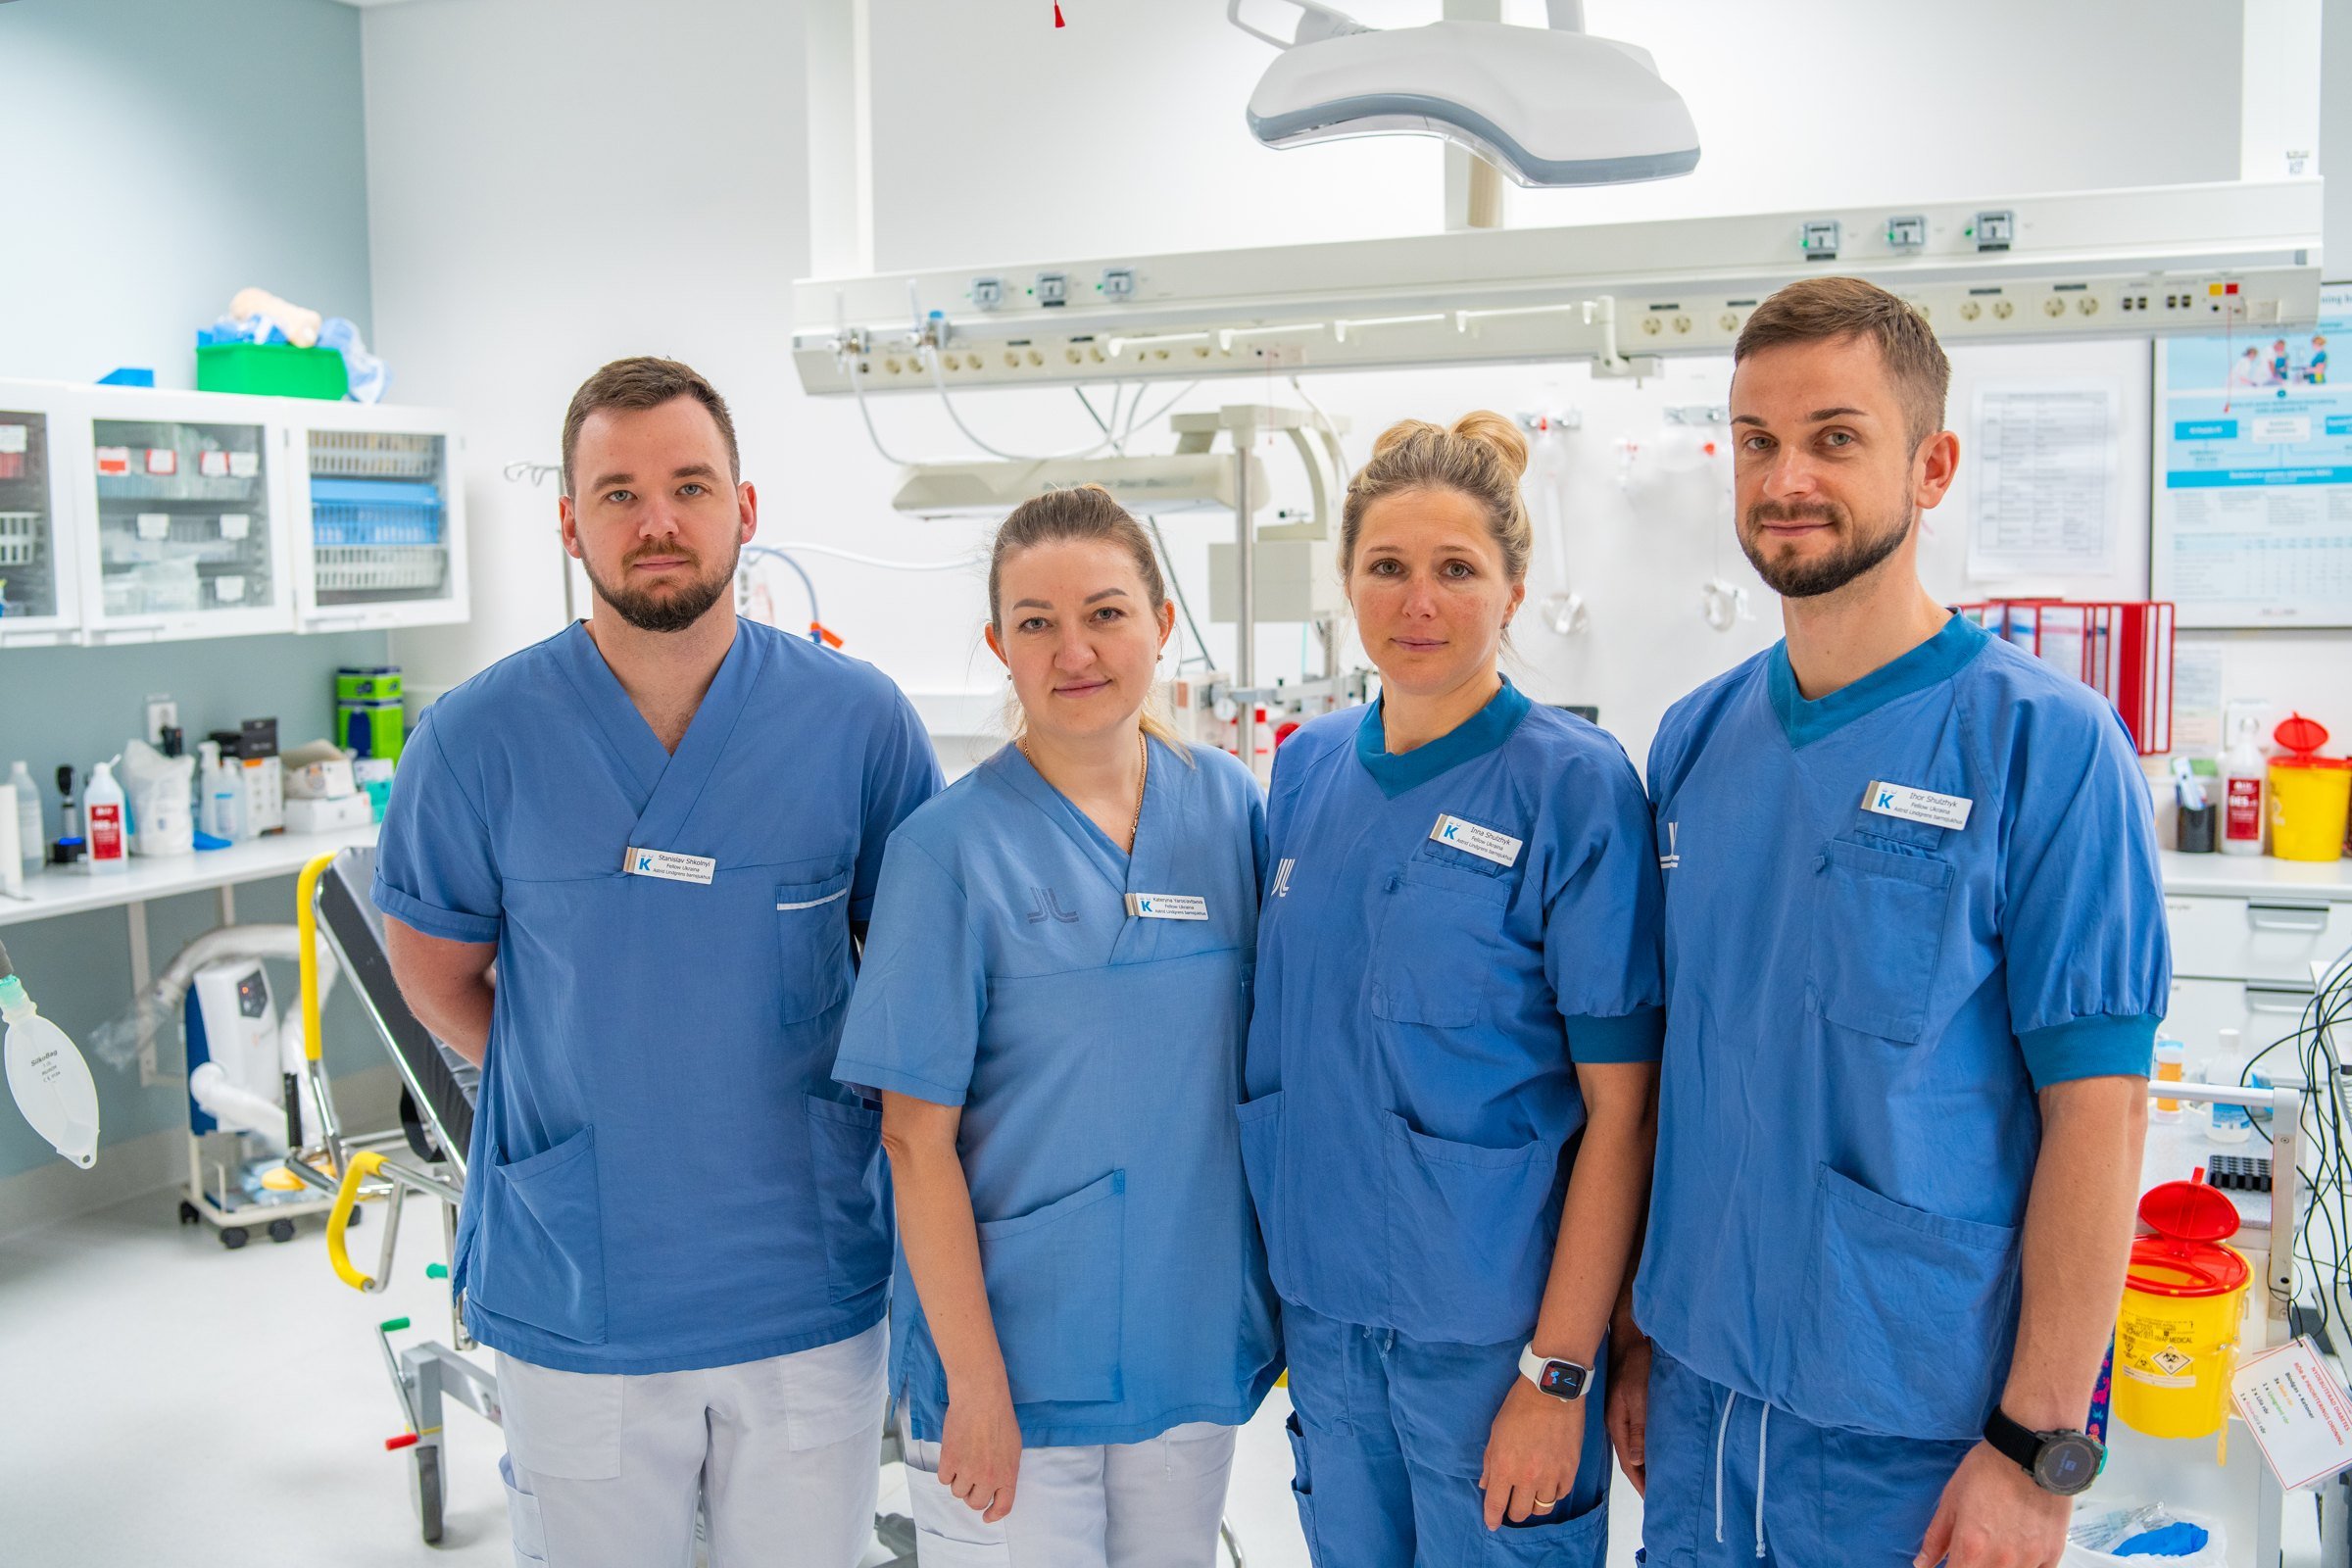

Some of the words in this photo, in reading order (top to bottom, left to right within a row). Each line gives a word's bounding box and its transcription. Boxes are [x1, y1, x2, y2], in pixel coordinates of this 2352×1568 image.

[1909, 793, 1924, 801] Ihor
[1926, 796, 1957, 808] Shulzhyk
[1909, 810, 1932, 819] Lindgrens
[1471, 827, 1484, 836] Inna
[1485, 833, 1510, 846] Shulzhyk
[1471, 836, 1486, 844] Fellow
[1486, 841, 1503, 850] Ukraina
[1469, 843, 1488, 853] Lindgrens
[1489, 850, 1512, 861] barnsjukhus
[659, 855, 684, 863] Stanislav
[686, 858, 710, 867] Shkolnyi
[2256, 1396, 2264, 1406] Lila
[2312, 1367, 2335, 1405] NYDEBUTERAD
[2333, 1406, 2350, 1431] DIABETES
[2300, 1398, 2314, 1419] Ketoner
[2304, 1380, 2330, 1420] PRIORITERINGS
[2327, 1420, 2344, 1446] ORDNING
